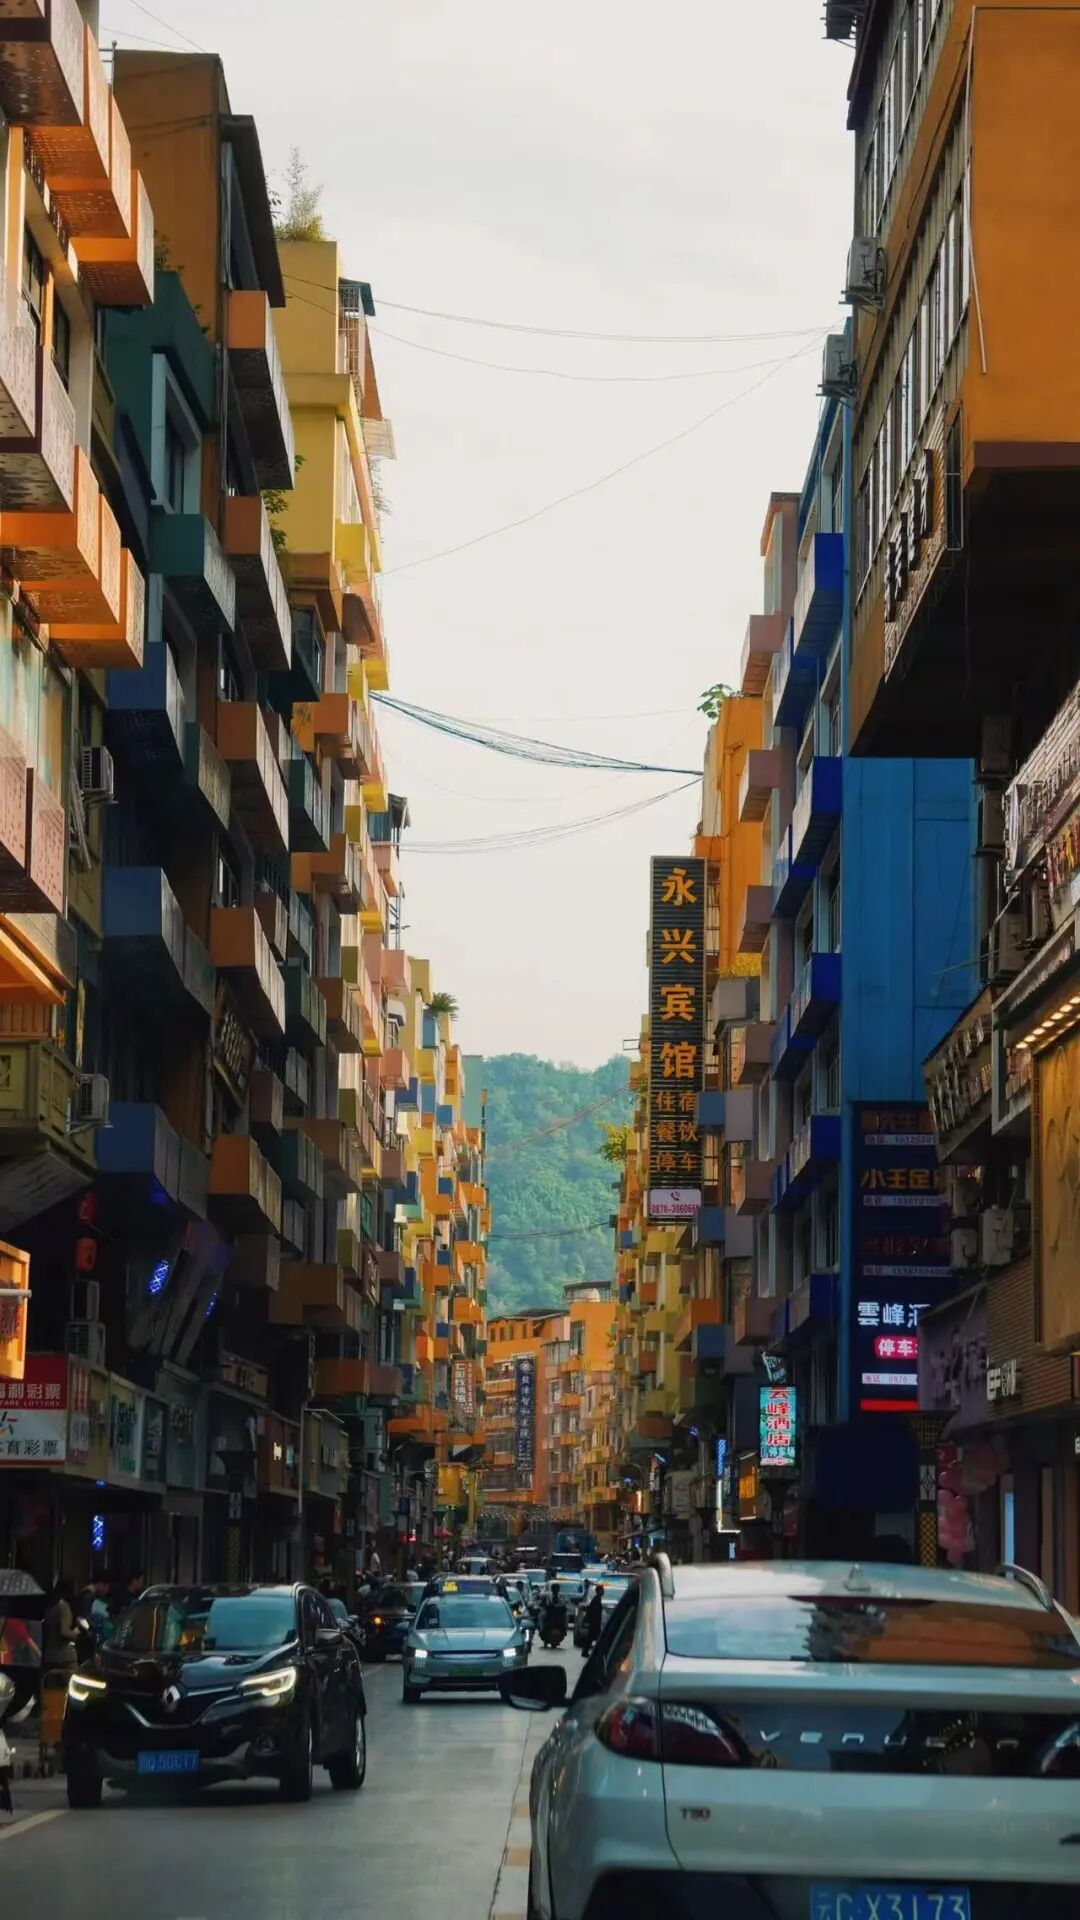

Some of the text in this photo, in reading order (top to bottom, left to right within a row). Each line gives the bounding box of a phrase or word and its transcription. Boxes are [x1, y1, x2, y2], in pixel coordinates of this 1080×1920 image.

[660, 867, 697, 1079] 永兴宾馆
[656, 1091, 696, 1112] 住宿
[656, 1121, 698, 1142] 餐饮
[656, 1151, 697, 1173] 停车
[878, 1339, 918, 1356] 停车
[0, 1440, 58, 1456] 育彩票
